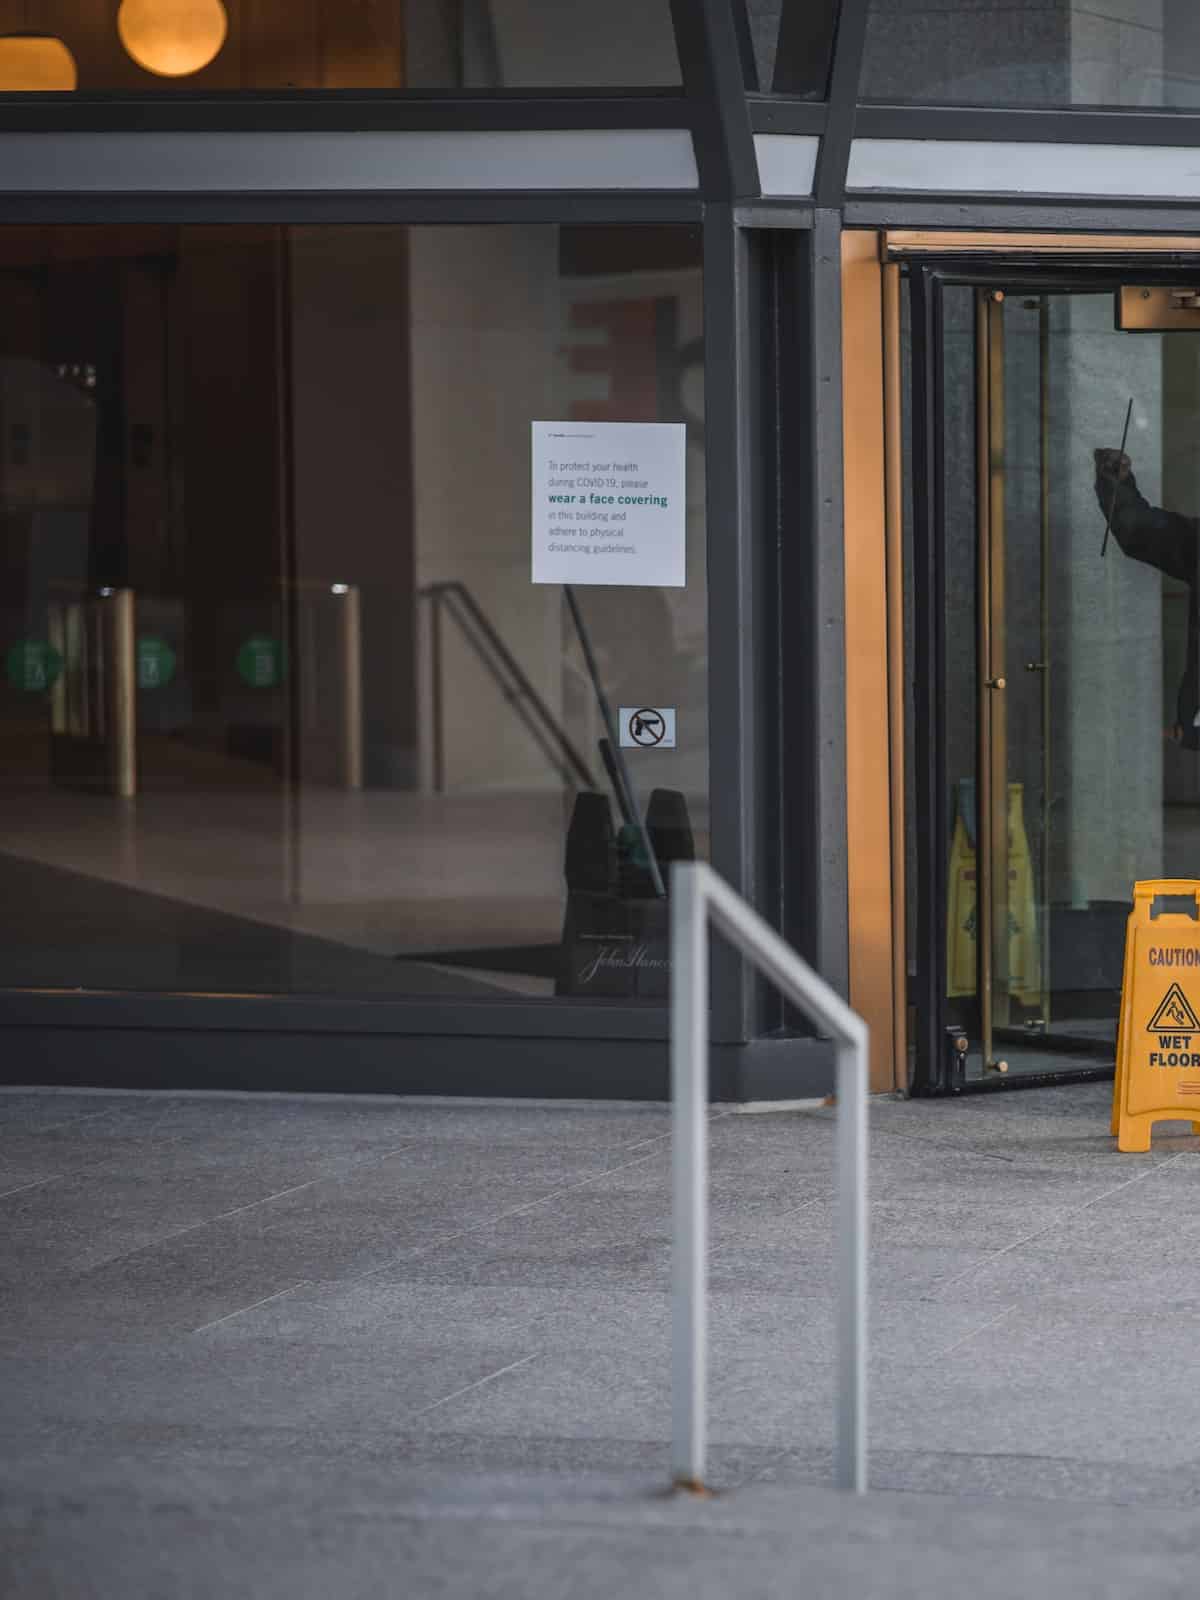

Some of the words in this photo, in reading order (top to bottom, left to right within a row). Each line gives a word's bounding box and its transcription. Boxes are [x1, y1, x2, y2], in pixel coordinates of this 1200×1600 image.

[560, 461, 590, 472] protect
[592, 463, 610, 473] your
[612, 461, 639, 472] health
[548, 478, 574, 488] during
[548, 494, 576, 503] wear
[579, 495, 586, 504] a
[590, 493, 615, 504] face
[617, 494, 668, 508] covering
[558, 511, 573, 521] this
[576, 511, 609, 522] building
[611, 512, 626, 521] and
[579, 528, 588, 537] to
[590, 528, 624, 538] physical
[547, 543, 590, 554] distancing
[1159, 1036, 1192, 1049] WET
[1149, 1053, 1200, 1067] FLOOR
